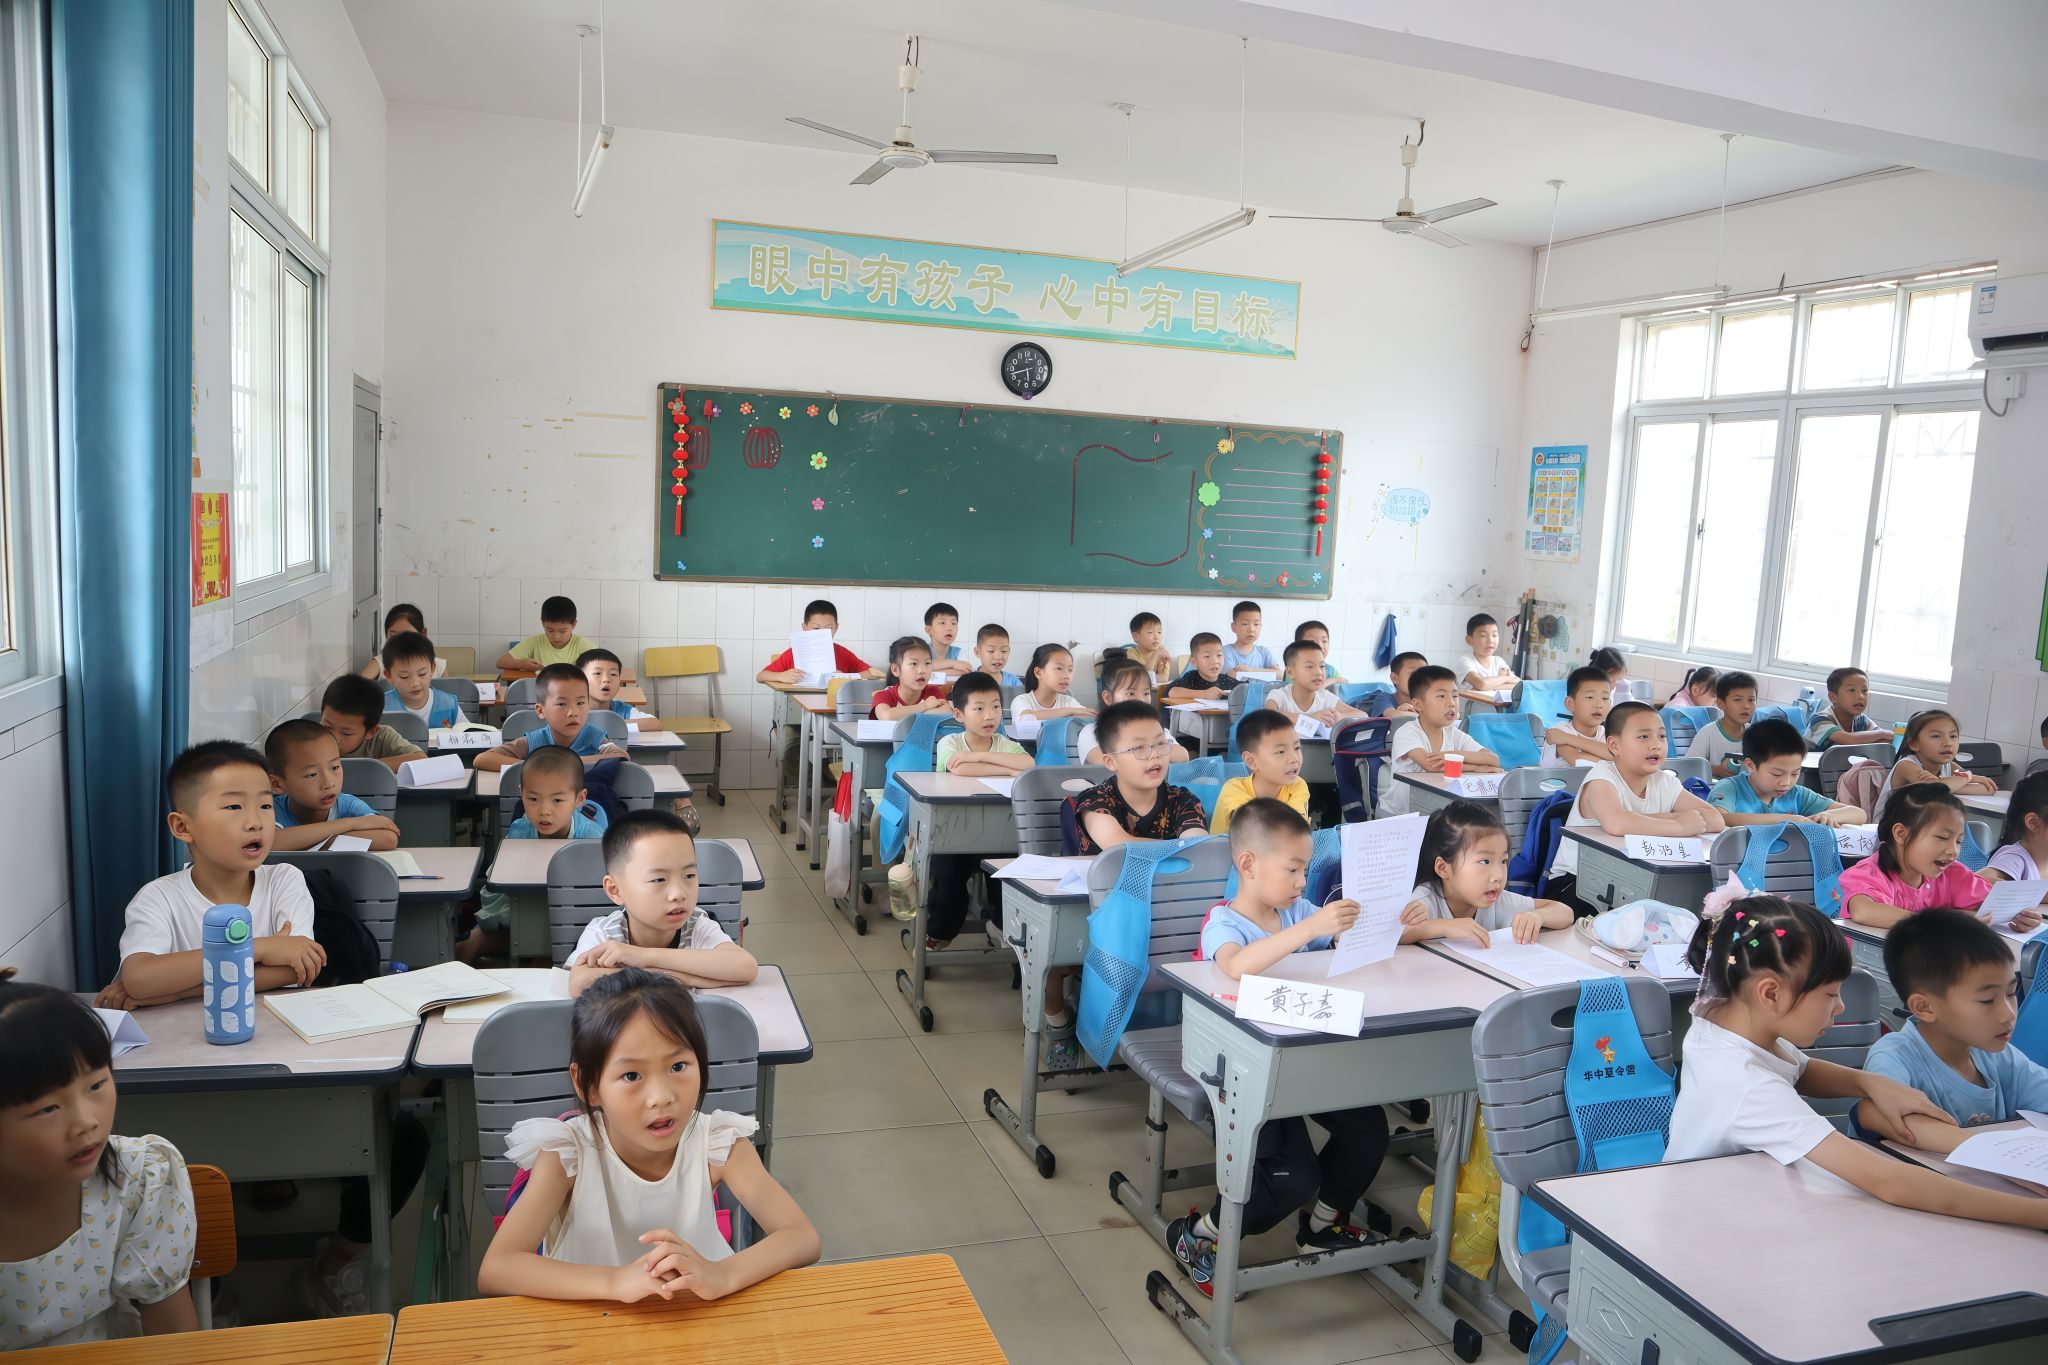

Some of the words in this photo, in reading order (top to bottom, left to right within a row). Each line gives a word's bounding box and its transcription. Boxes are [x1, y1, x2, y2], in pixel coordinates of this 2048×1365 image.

[749, 244, 1014, 313] 眼中有孩子
[1039, 274, 1272, 339] 心中有目标
[1264, 985, 1336, 1020] 黄子嘉
